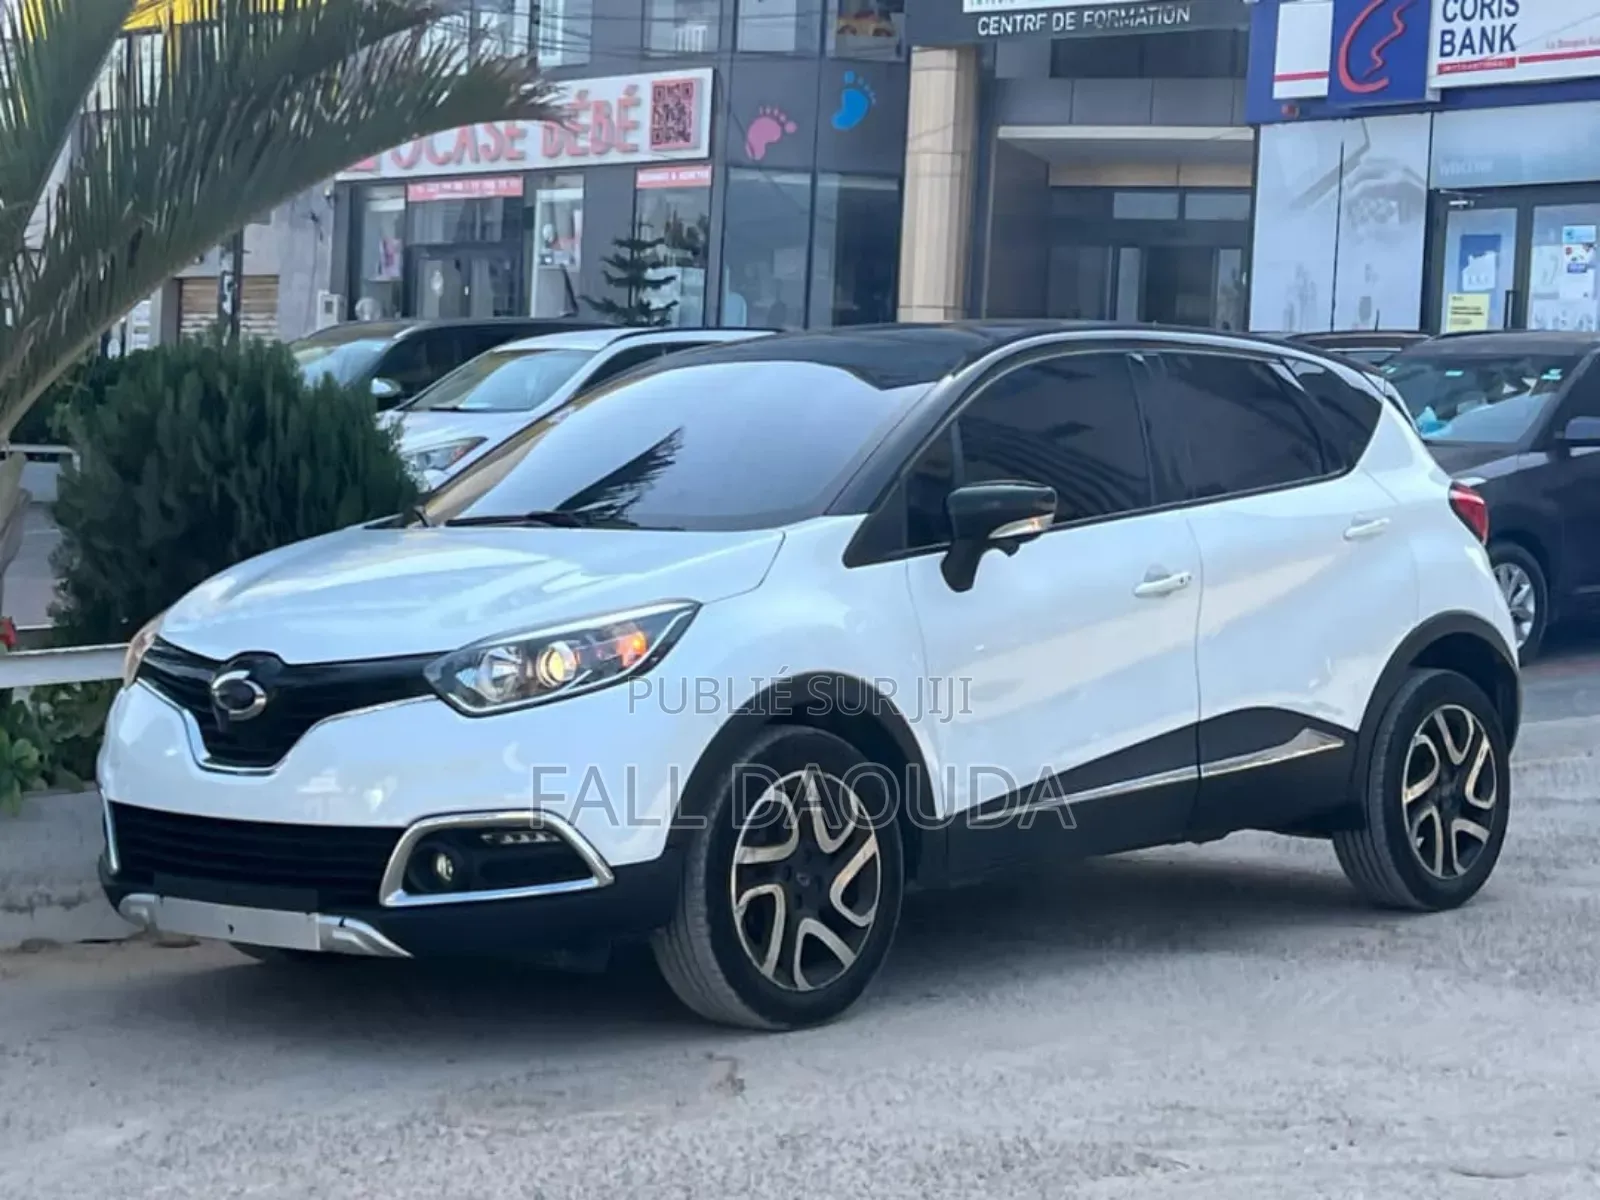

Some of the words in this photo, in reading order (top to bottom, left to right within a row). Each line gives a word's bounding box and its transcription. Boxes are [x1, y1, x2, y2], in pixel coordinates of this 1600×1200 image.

[1052, 11, 1077, 31] DE
[1083, 5, 1191, 29] FORMATION
[1442, 0, 1520, 23] CORIS
[1439, 23, 1518, 58] BANK
[541, 84, 642, 159] BÉBÉ
